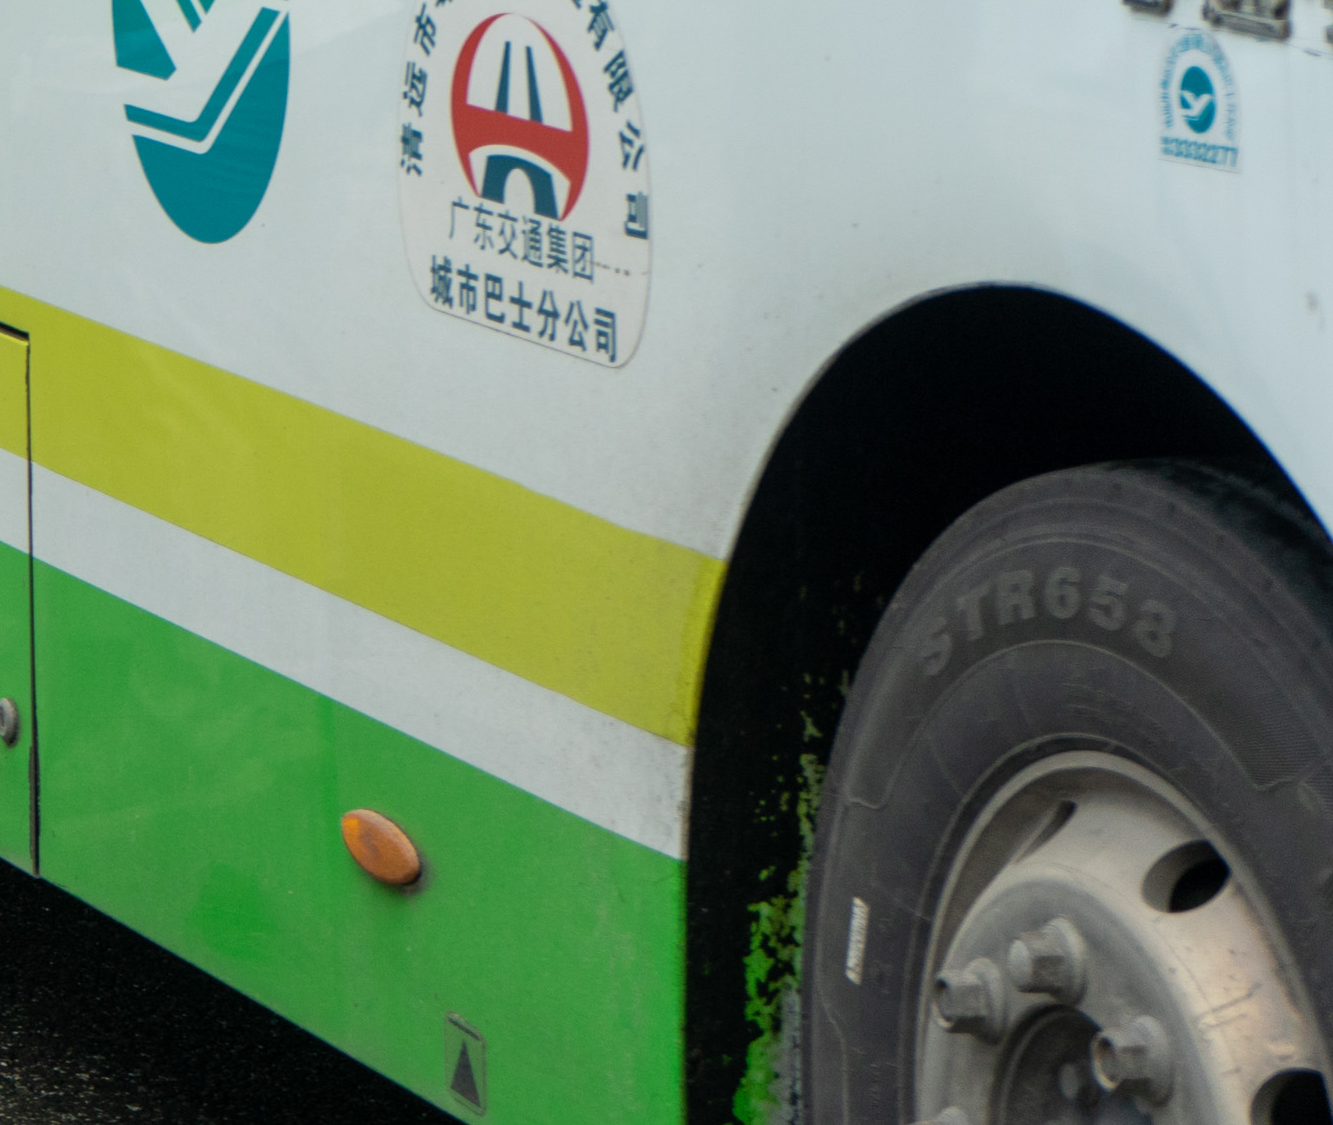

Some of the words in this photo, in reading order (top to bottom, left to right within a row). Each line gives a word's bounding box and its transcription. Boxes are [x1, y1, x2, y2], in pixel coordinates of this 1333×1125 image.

[449, 196, 594, 284] 广东交通集团
[430, 254, 617, 363] 城市巴士分公司
[920, 566, 1178, 677] STR658
